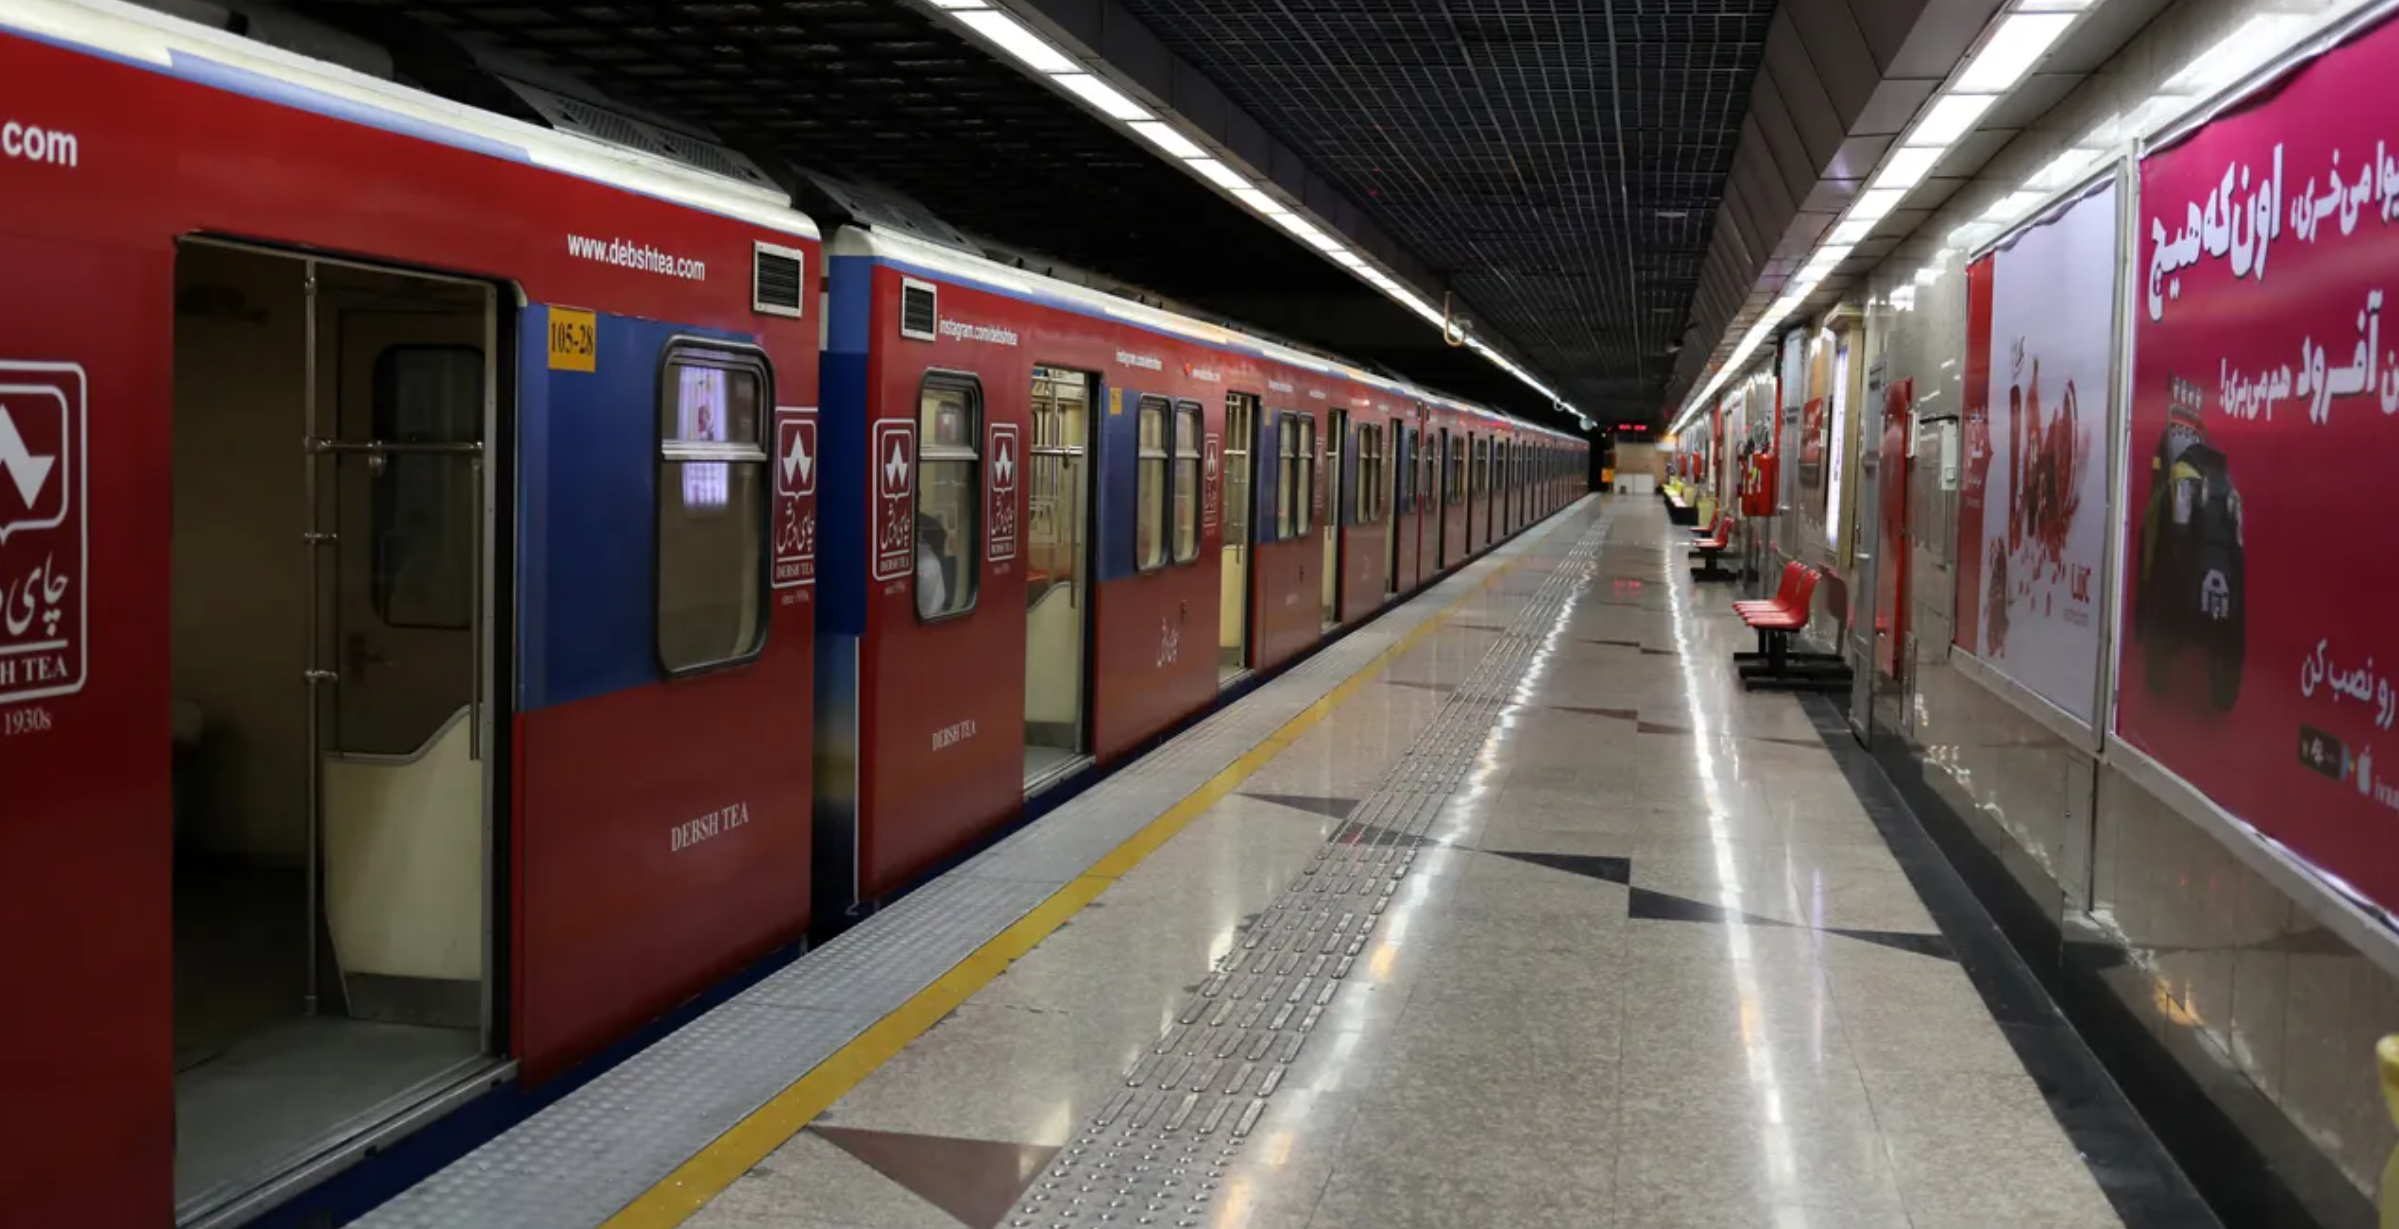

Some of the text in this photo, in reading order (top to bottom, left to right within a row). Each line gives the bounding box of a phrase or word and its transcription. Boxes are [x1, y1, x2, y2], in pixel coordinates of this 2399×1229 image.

[567, 233, 705, 281] www.debshtea.com
[2148, 200, 2203, 322] هیچ
[550, 321, 594, 356] 105-28
[2297, 289, 2384, 426] آفرود
[6, 552, 69, 637] چای
[22, 655, 68, 682] TEA
[2301, 638, 2396, 730] رو نصب کن
[5, 707, 52, 735] 1930s
[671, 800, 749, 852] DEBSH TEA
